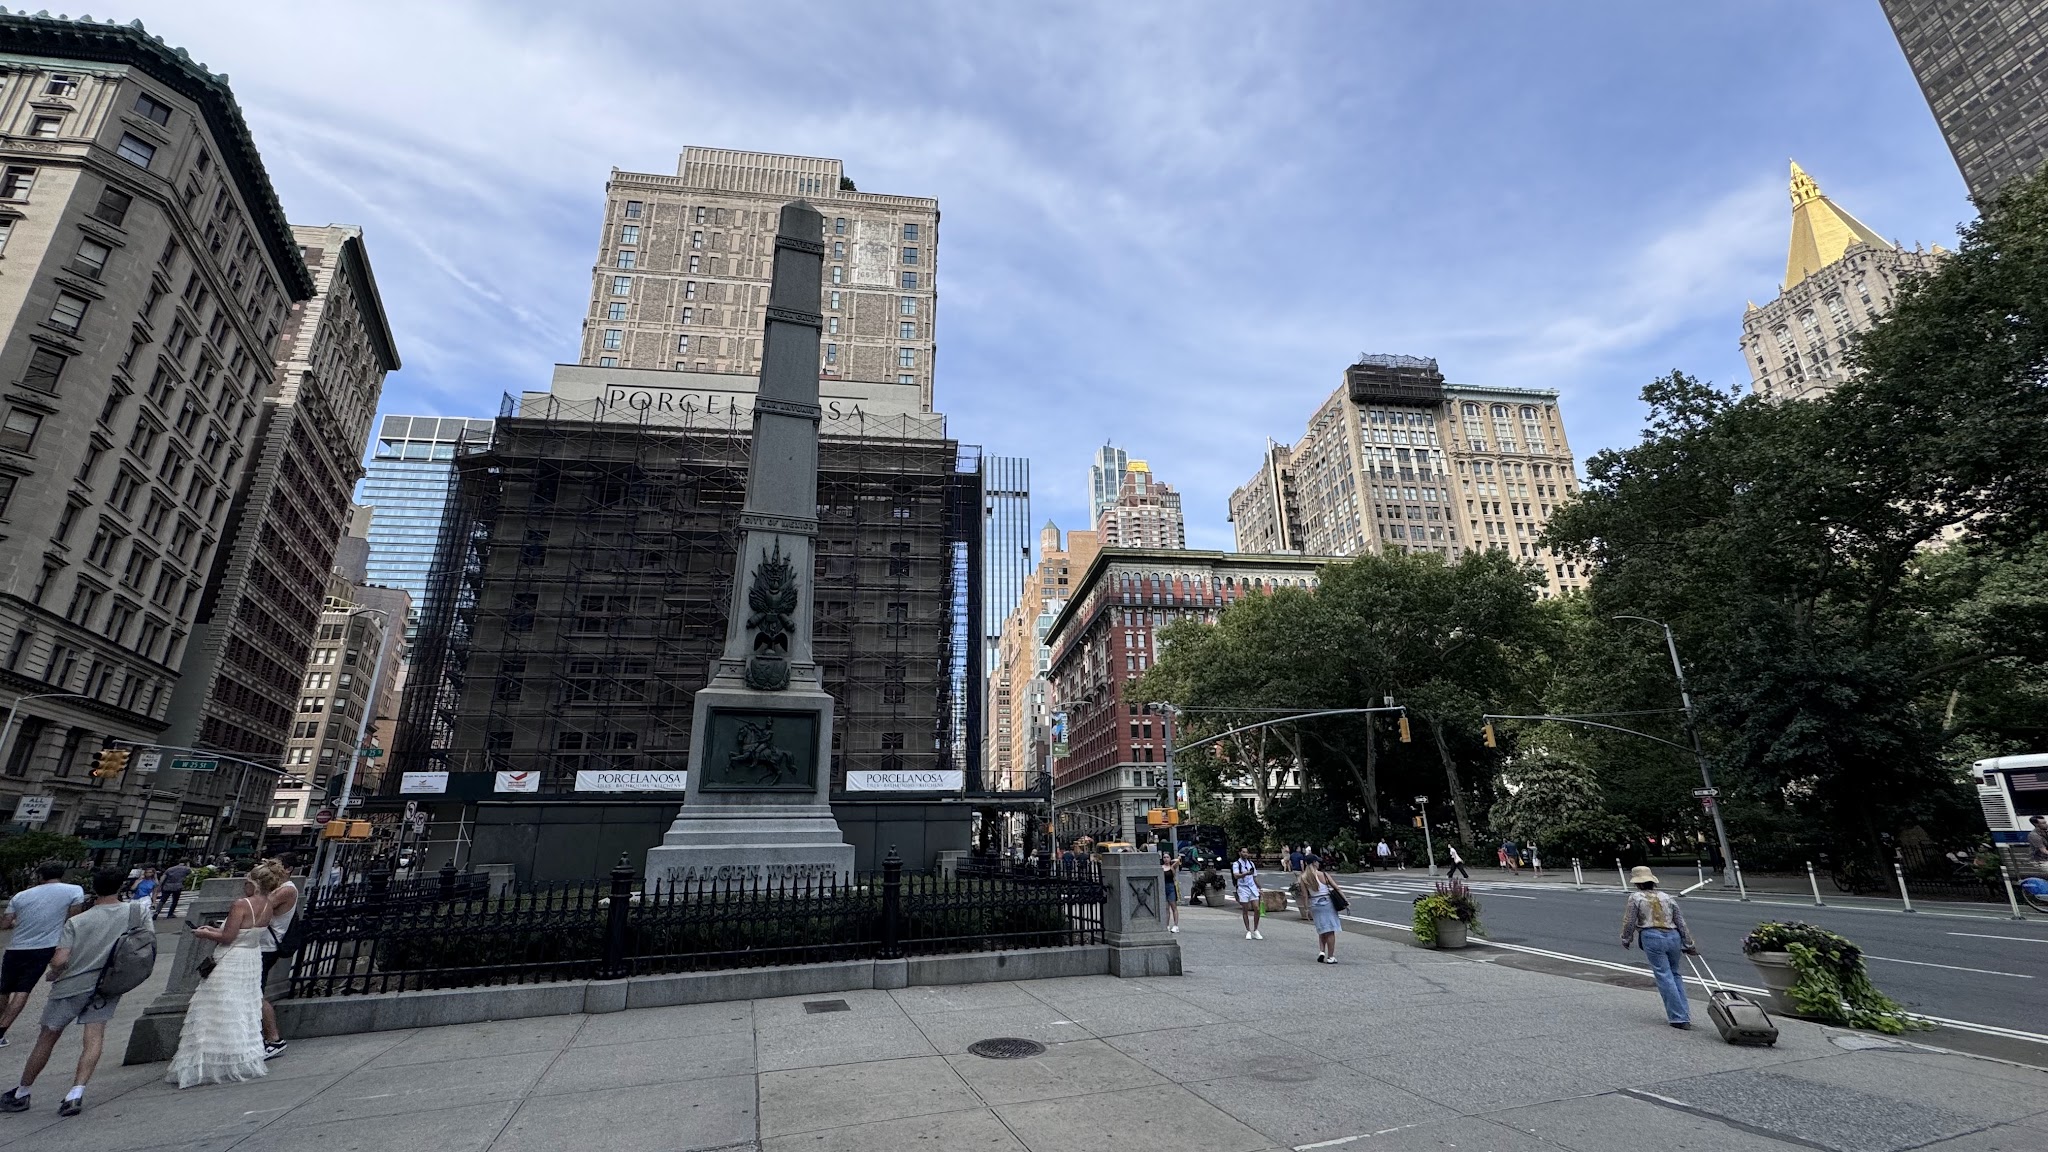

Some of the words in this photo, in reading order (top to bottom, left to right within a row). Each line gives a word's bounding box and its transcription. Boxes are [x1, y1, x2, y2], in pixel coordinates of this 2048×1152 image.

[609, 389, 864, 422] PORCELSA
[743, 517, 765, 526] CITY
[767, 519, 779, 527] OF
[781, 520, 815, 531] MEXICO
[368, 749, 376, 757] 25
[189, 761, 198, 769] 25
[597, 773, 681, 783] PORCELANOSA
[866, 773, 944, 783] PORCELANOSA
[766, 863, 837, 881] WORTH
